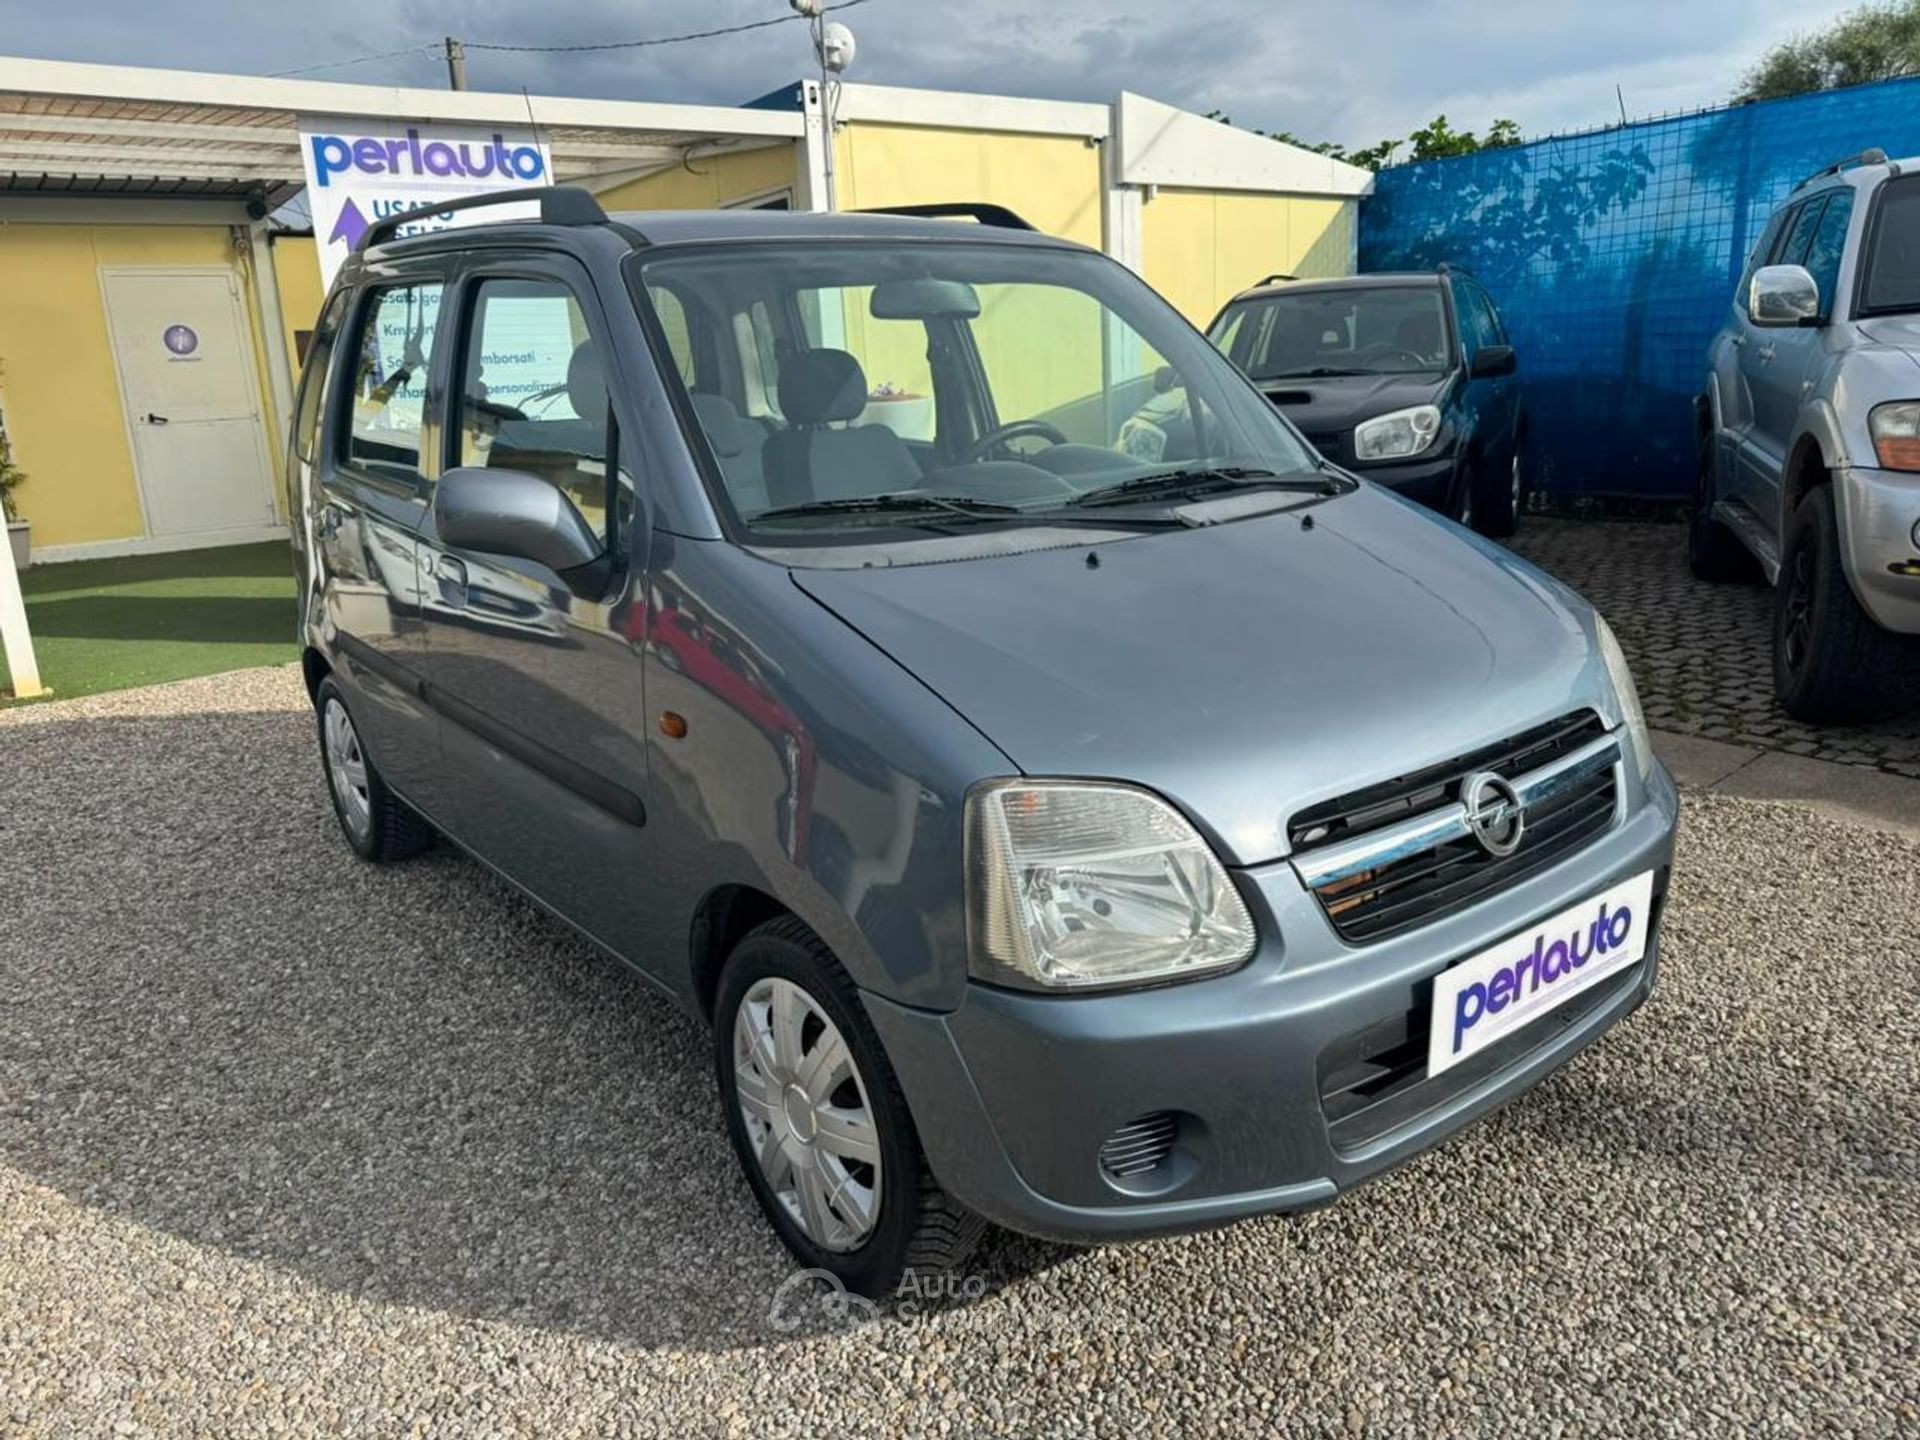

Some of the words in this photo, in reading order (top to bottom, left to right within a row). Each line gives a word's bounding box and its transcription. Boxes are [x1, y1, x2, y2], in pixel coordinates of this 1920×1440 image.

[311, 129, 545, 187] perlauto
[481, 350, 536, 364] mborsati
[1453, 903, 1632, 1054] perlauto
